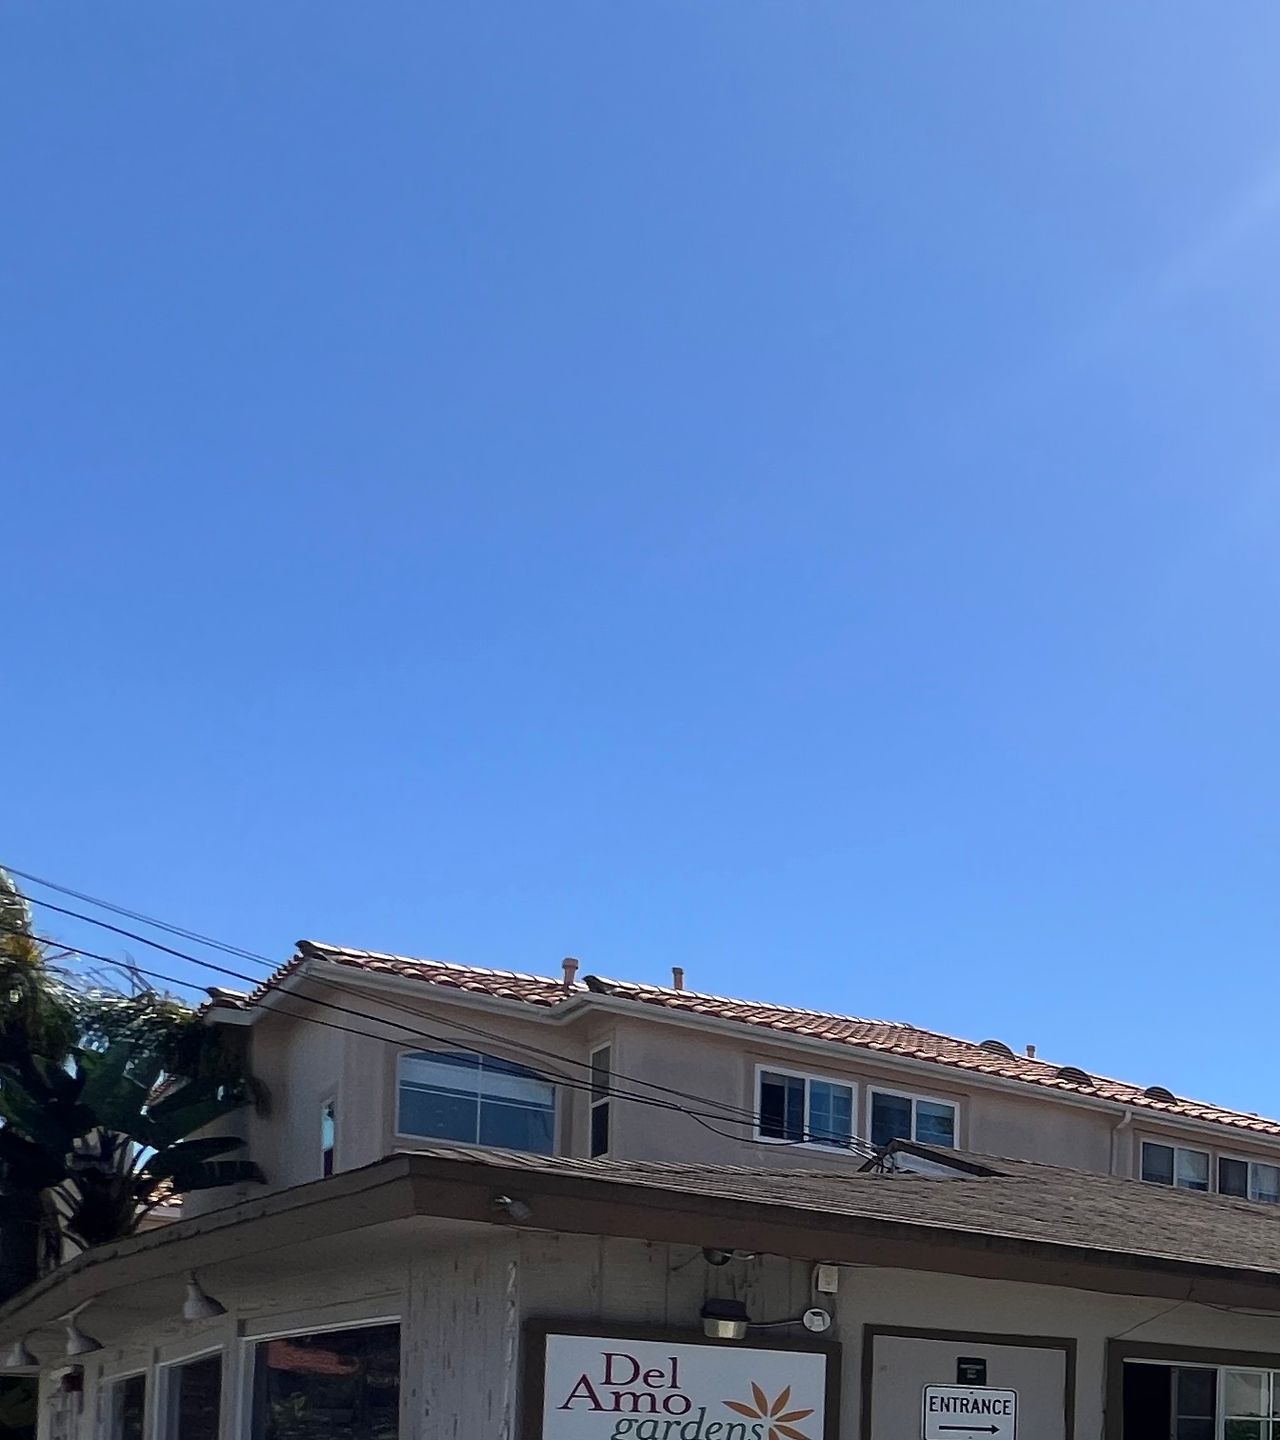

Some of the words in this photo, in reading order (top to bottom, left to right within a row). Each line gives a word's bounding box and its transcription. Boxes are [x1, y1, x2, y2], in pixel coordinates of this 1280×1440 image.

[601, 1352, 681, 1389] Del
[556, 1374, 692, 1415] Amo
[929, 1395, 1012, 1416] ENTRANCE
